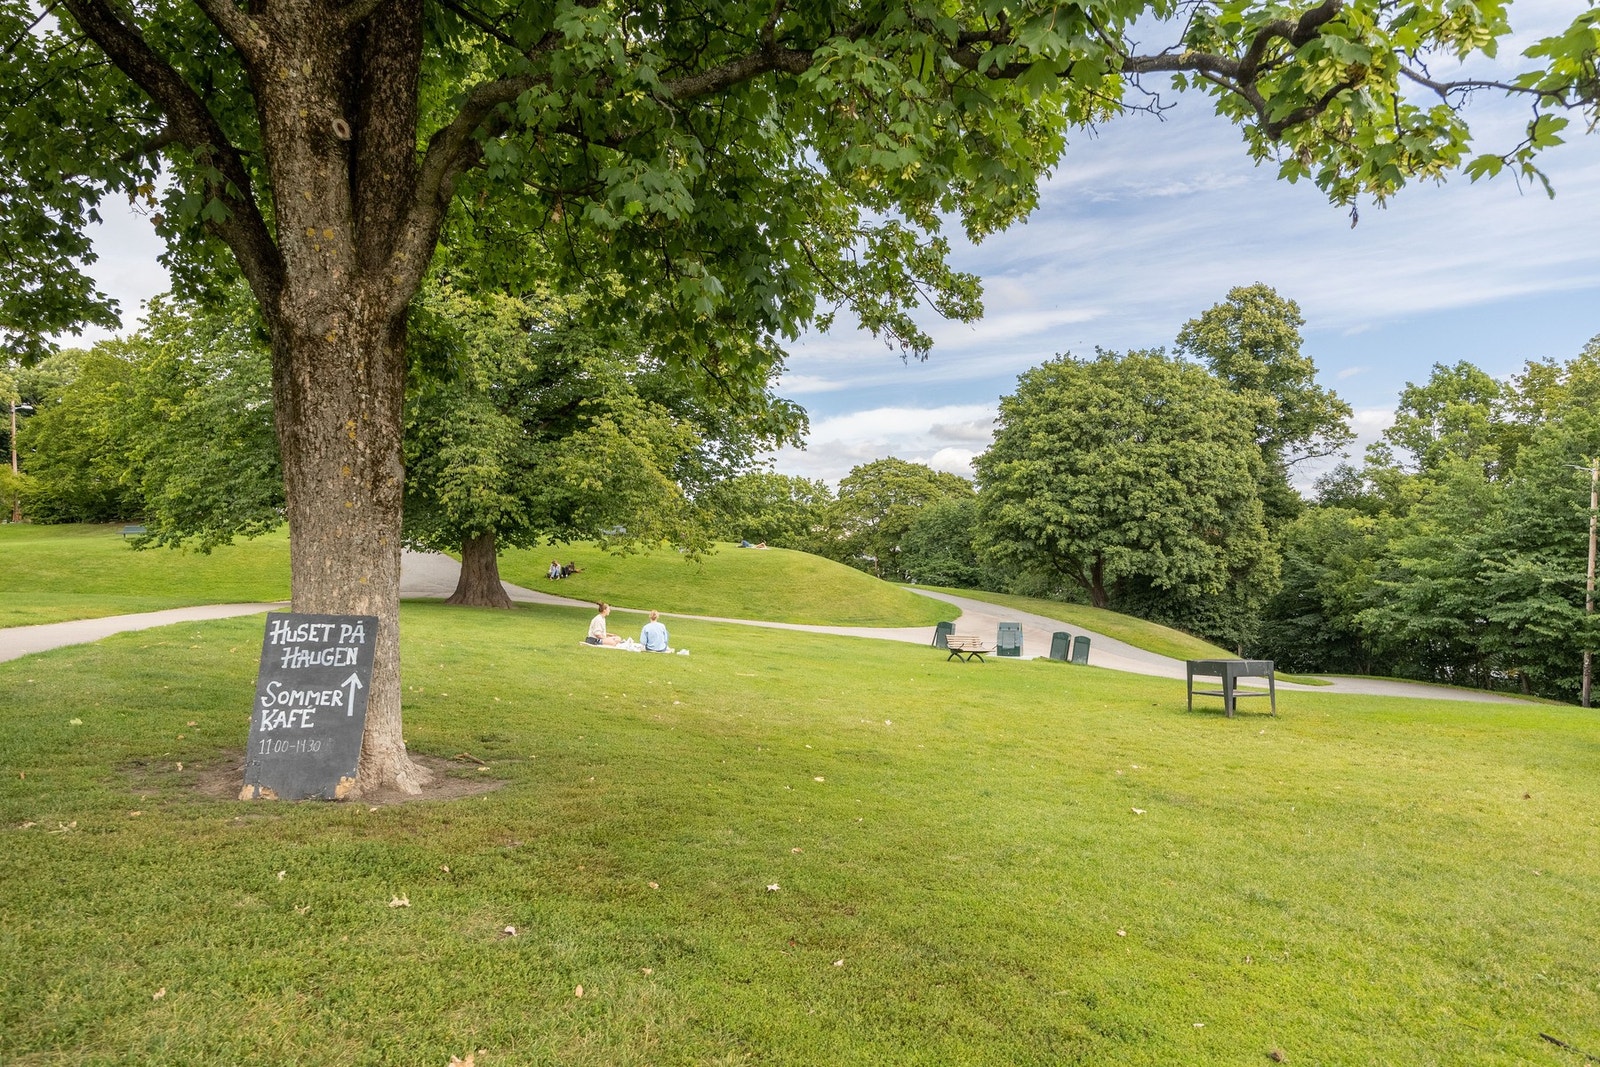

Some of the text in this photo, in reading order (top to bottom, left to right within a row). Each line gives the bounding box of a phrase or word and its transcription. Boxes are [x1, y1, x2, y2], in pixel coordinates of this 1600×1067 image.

[270, 620, 365, 645] HUSET PÅ
[281, 646, 358, 669] HAUGEN
[261, 681, 343, 707] SOMMER
[260, 705, 316, 731] KAFÉ
